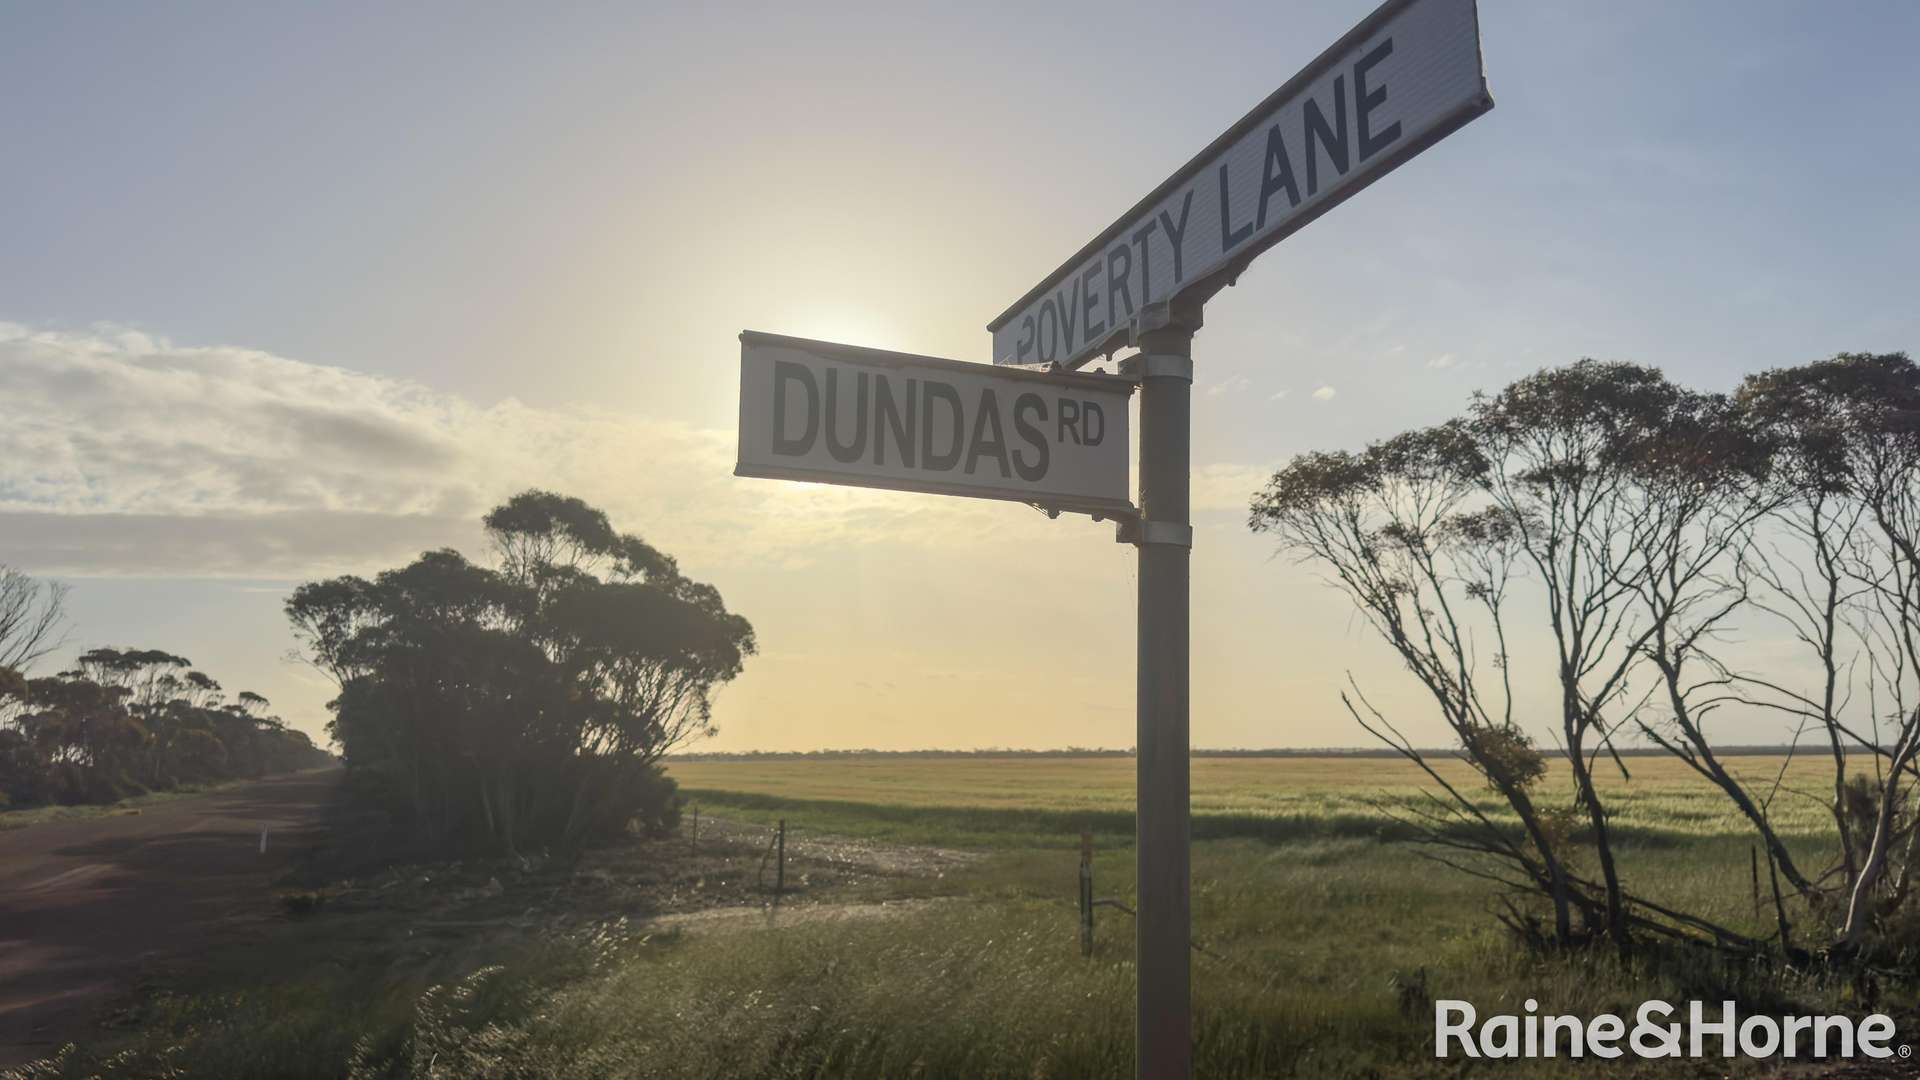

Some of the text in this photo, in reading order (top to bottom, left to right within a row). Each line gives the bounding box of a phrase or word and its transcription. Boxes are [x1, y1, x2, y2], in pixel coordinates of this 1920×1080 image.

[1016, 37, 1402, 364] POVERTY LANE
[771, 360, 1104, 482] DUNDAS RD
